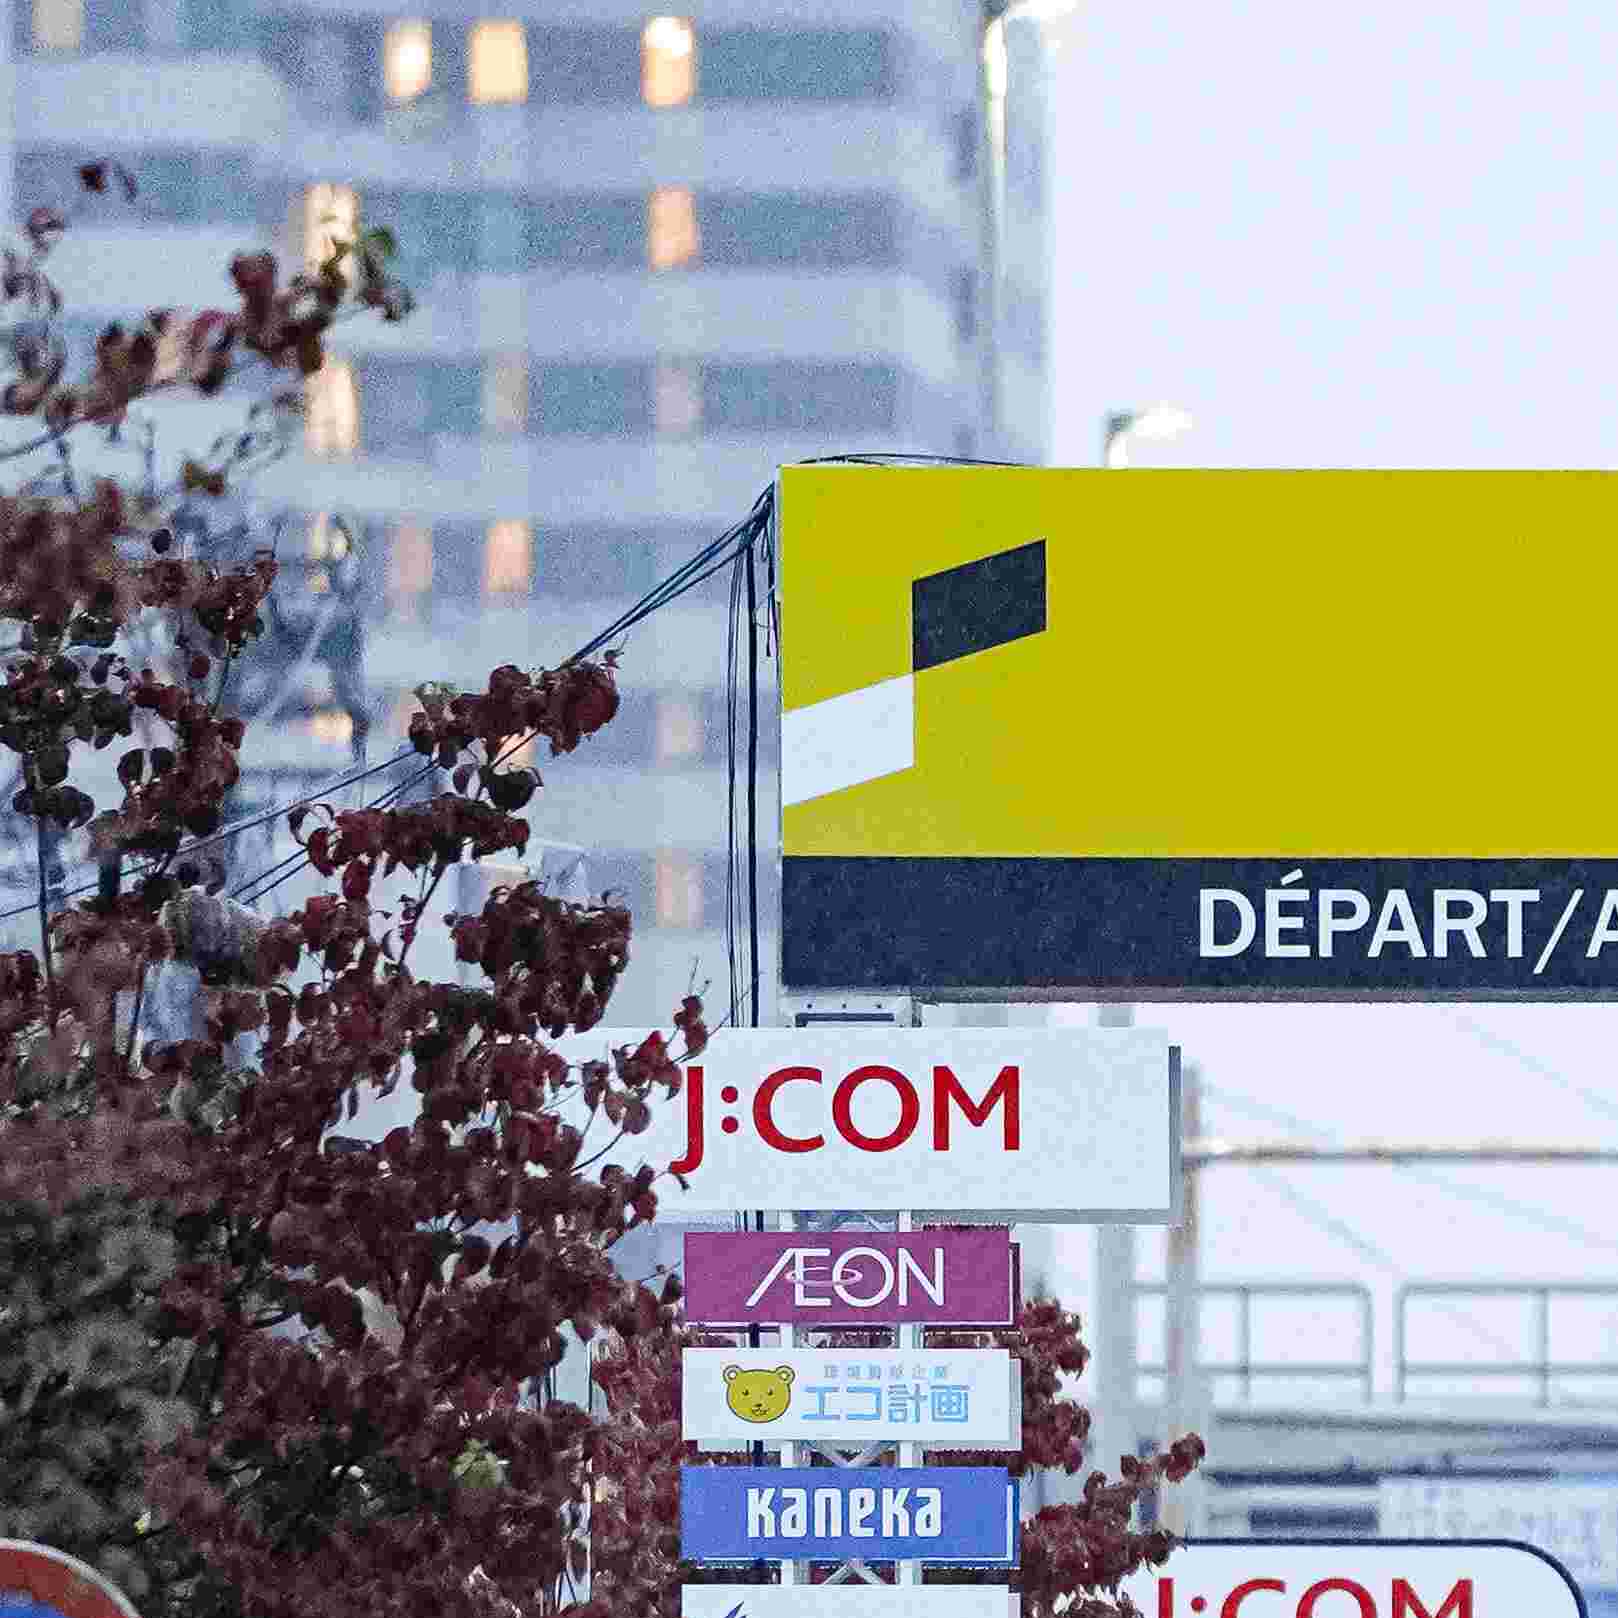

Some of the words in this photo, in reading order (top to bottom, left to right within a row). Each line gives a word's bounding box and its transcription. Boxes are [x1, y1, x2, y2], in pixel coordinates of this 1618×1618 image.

[671, 1065, 1021, 1174] J:COM
[800, 1384, 970, 1425] エコ計画
